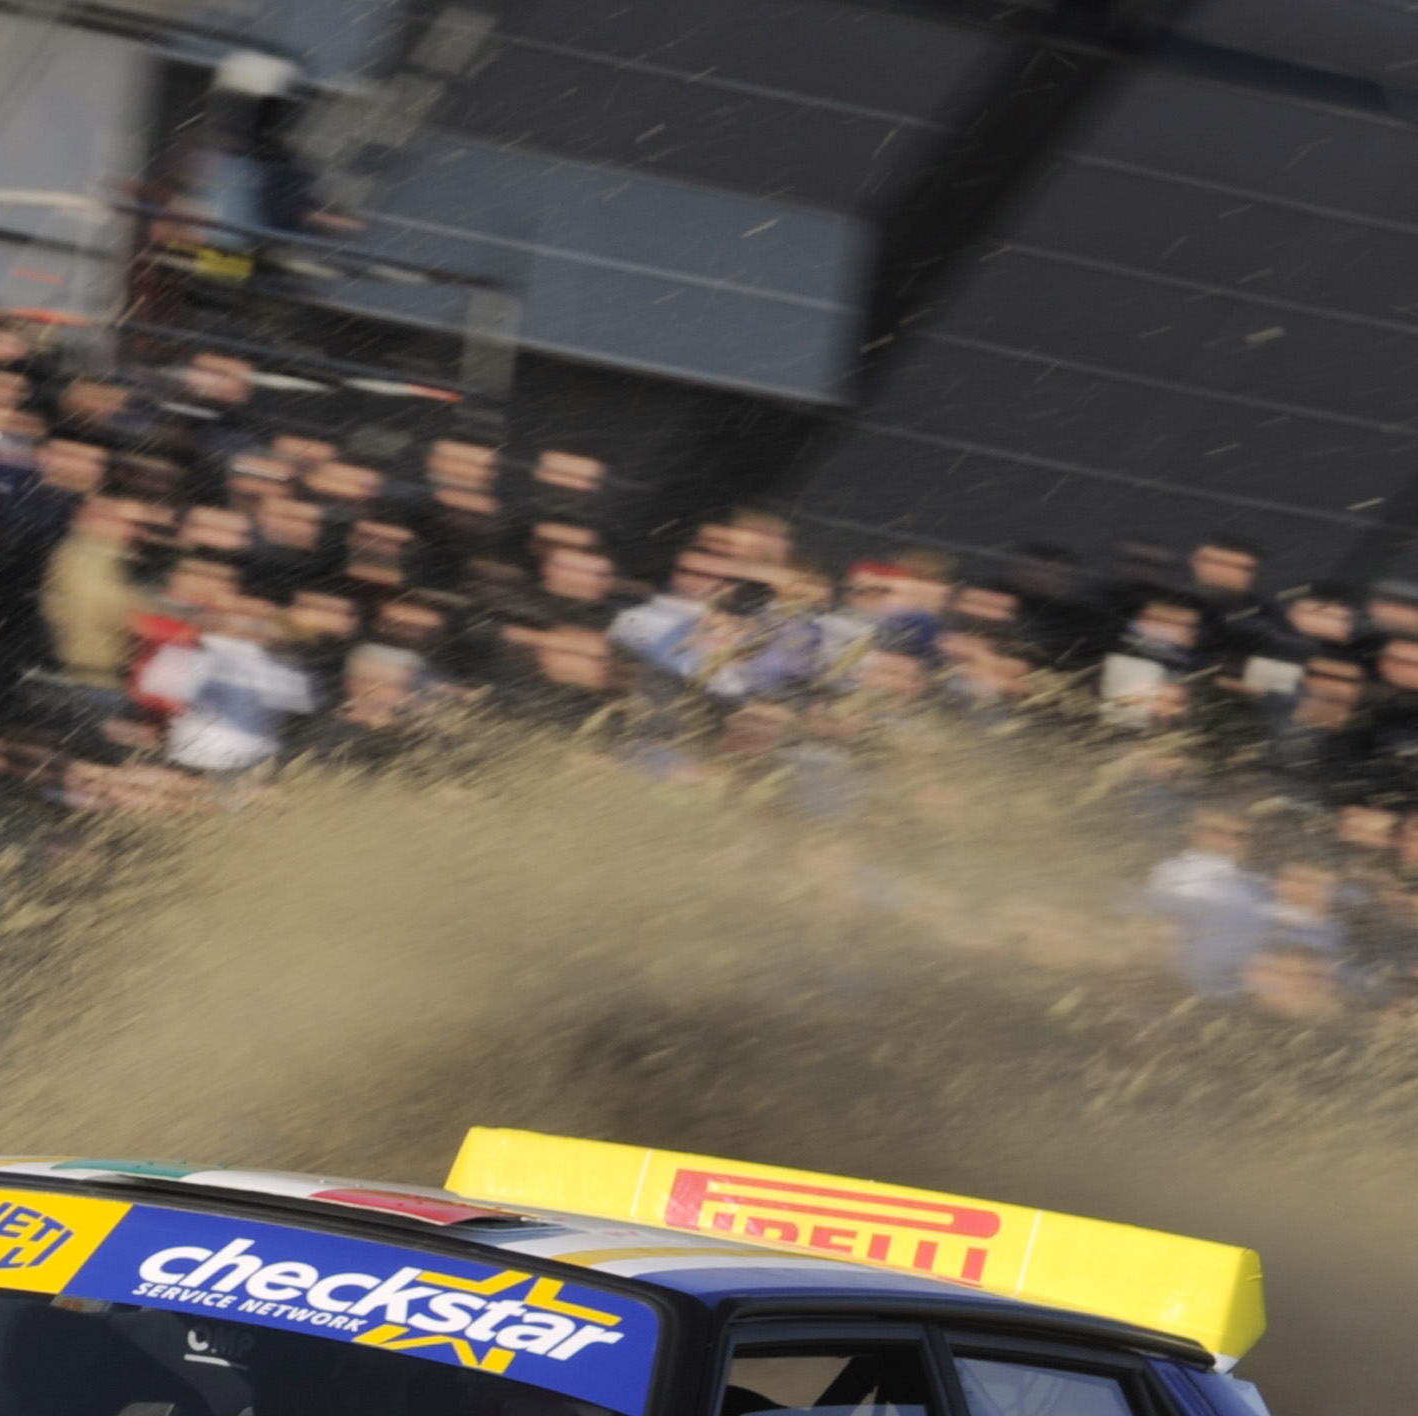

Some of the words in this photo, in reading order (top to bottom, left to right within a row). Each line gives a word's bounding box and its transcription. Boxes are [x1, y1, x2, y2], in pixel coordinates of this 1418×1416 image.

[132, 1281, 233, 1310] SERVICE
[237, 1297, 369, 1333] NETWORK
[138, 1237, 624, 1361] checkstar
